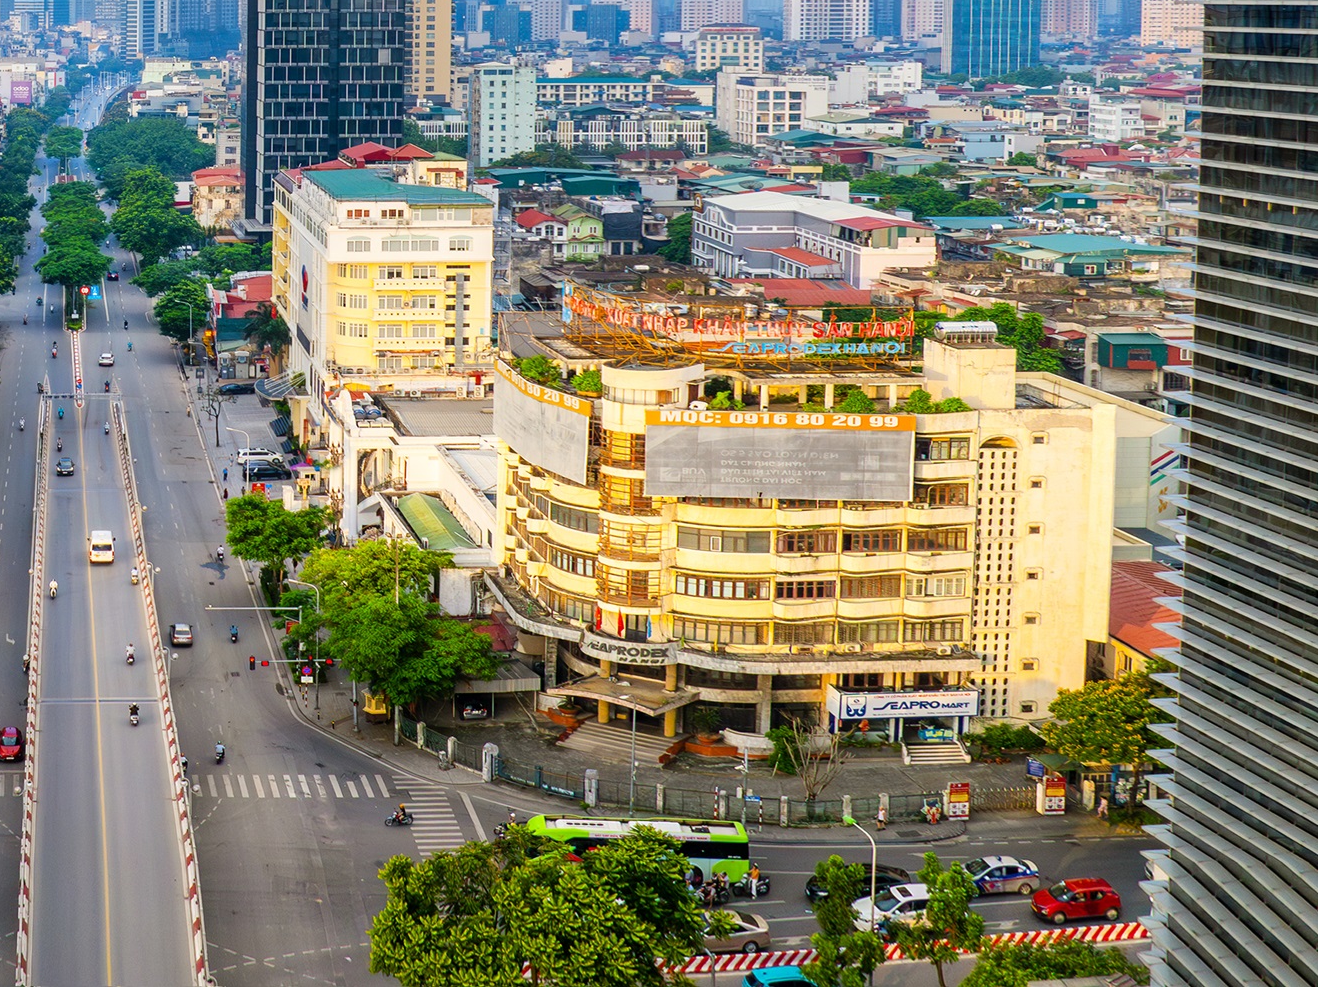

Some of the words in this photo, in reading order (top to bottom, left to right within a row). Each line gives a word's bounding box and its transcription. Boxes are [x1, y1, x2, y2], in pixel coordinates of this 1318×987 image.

[527, 385, 541, 397] 80
[544, 389, 559, 403] 20
[564, 395, 580, 410] 99
[729, 413, 788, 425] 0916
[796, 414, 820, 426] 80
[832, 414, 861, 427] 20
[869, 415, 899, 428] 99
[587, 640, 669, 658] SEAPRODEX
[873, 701, 940, 710] SEAPRO
